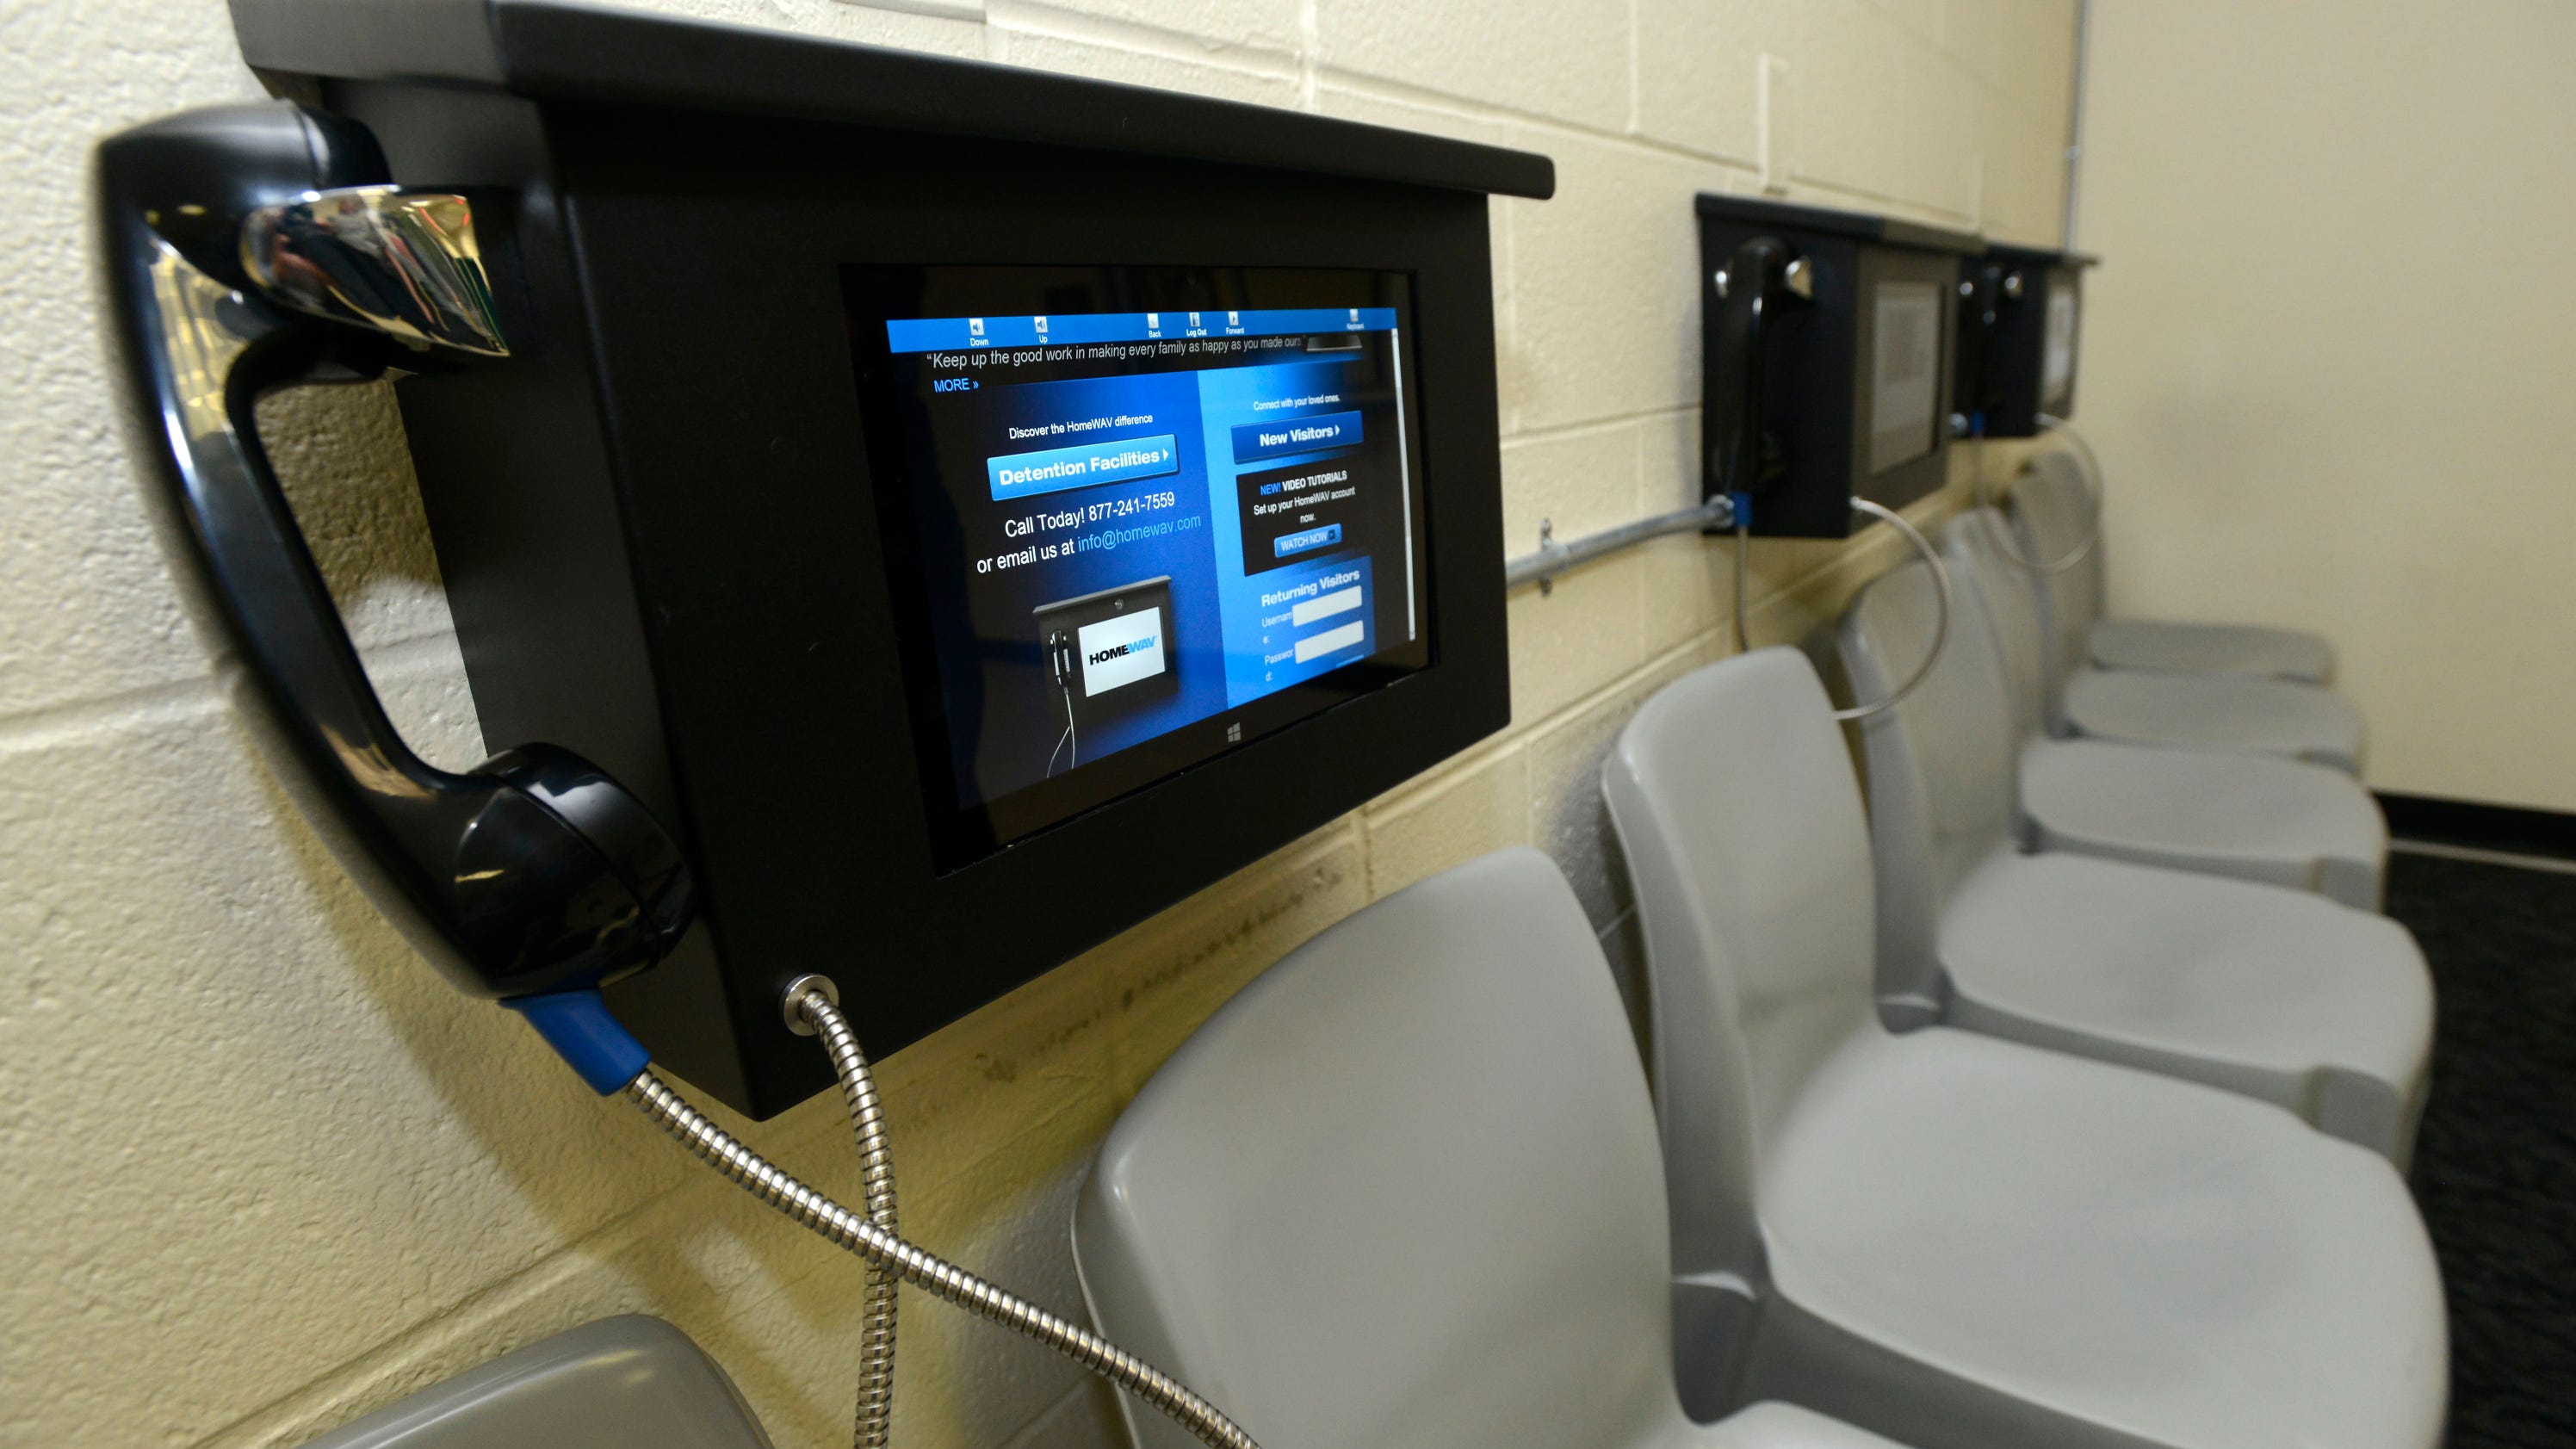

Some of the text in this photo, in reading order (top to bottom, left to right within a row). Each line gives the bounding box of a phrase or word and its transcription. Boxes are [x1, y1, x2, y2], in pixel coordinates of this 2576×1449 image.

[970, 337, 989, 347] Down
[1039, 335, 1048, 344] Up
[1186, 329, 1197, 337] Log
[971, 354, 987, 369] up
[991, 350, 1010, 365] the
[1013, 348, 1043, 367] good
[1046, 346, 1073, 362] work
[1076, 345, 1085, 360] in
[1088, 343, 1126, 360] making
[1129, 343, 1155, 359] every
[1158, 339, 1186, 356] family
[1189, 342, 1200, 352] as
[1202, 339, 1229, 355] happy
[1231, 340, 1242, 350] as
[1243, 339, 1259, 352] you
[1260, 336, 1284, 348] made
[933, 377, 970, 393] MORE
[1254, 394, 1341, 411] Connect with your loved ones.
[1009, 414, 1153, 440] Discover the HomeWAV difference
[1260, 426, 1334, 447] New Visitors
[999, 448, 1161, 486] Detention Facilities
[1260, 470, 1347, 496] NEW! VIDEO TUTORIALS
[1254, 486, 1356, 516] Set up your HomeWAV account
[1005, 491, 1175, 538] Call Today! 877-241-7559
[1300, 514, 1316, 523] now.
[976, 514, 1201, 573] or email us at info@homewav.com
[1281, 530, 1328, 551] WATCH NOW
[1261, 570, 1360, 607] Returning Visitors
[1262, 611, 1292, 628] Usernam
[1265, 648, 1295, 666] Passwor
